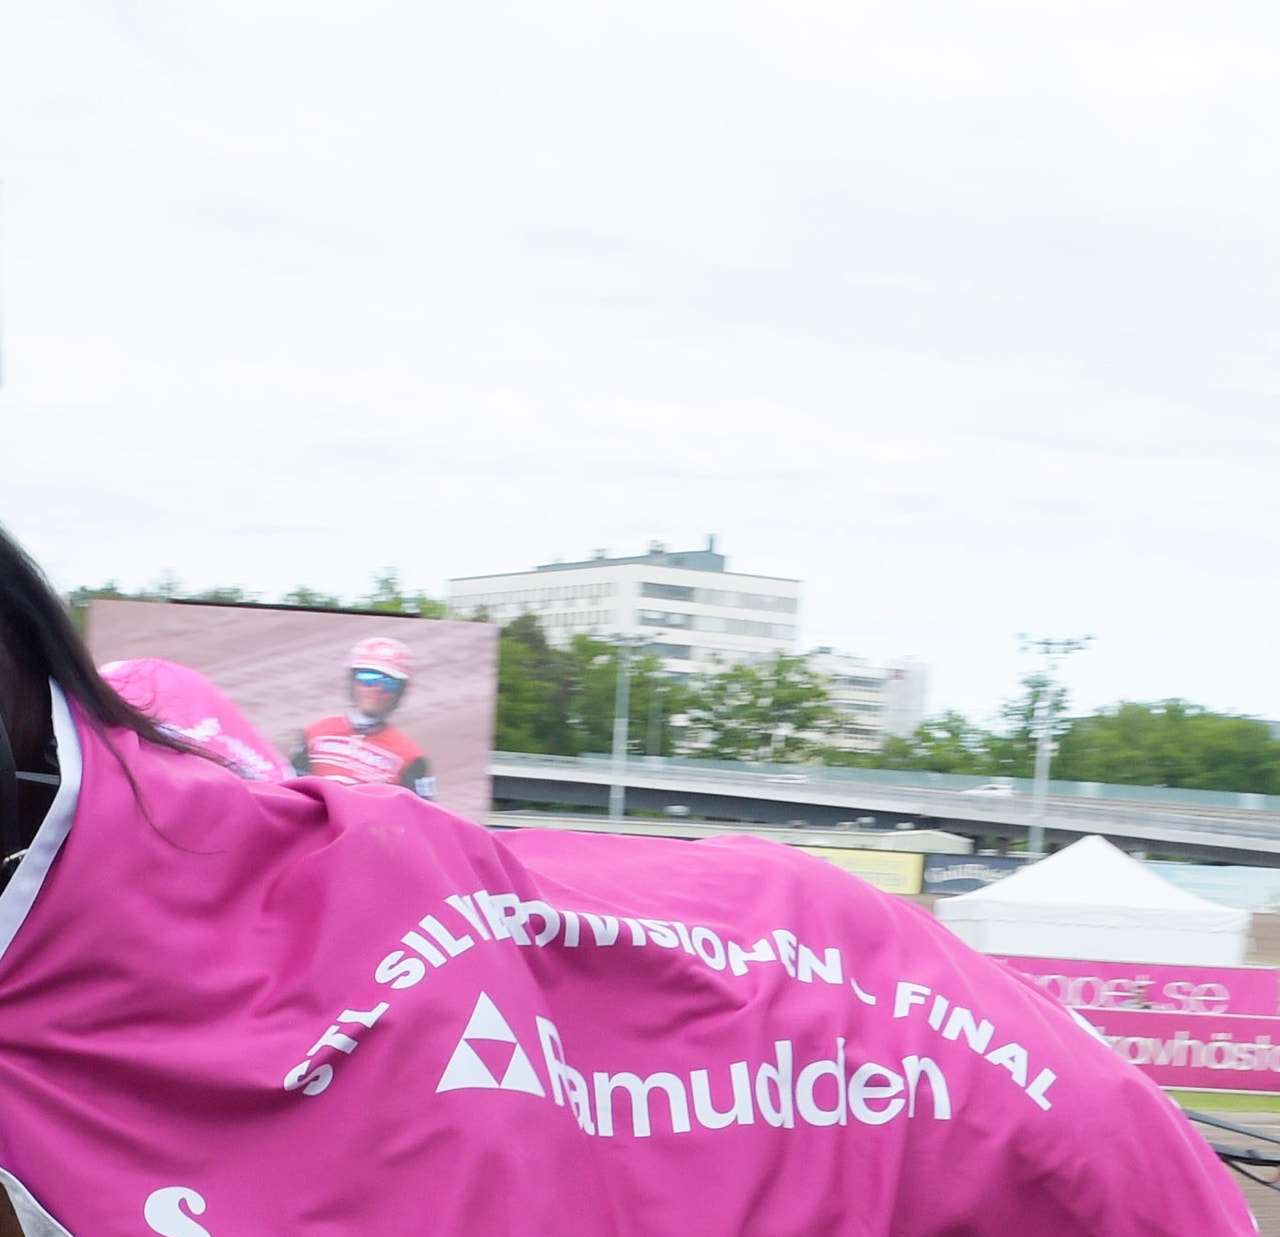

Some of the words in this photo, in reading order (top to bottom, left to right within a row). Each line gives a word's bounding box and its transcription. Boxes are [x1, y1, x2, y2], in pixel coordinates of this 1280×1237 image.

[283, 1001, 391, 1096] STL
[892, 981, 1058, 1112] FINAL
[535, 1015, 952, 1138] Ramudden
